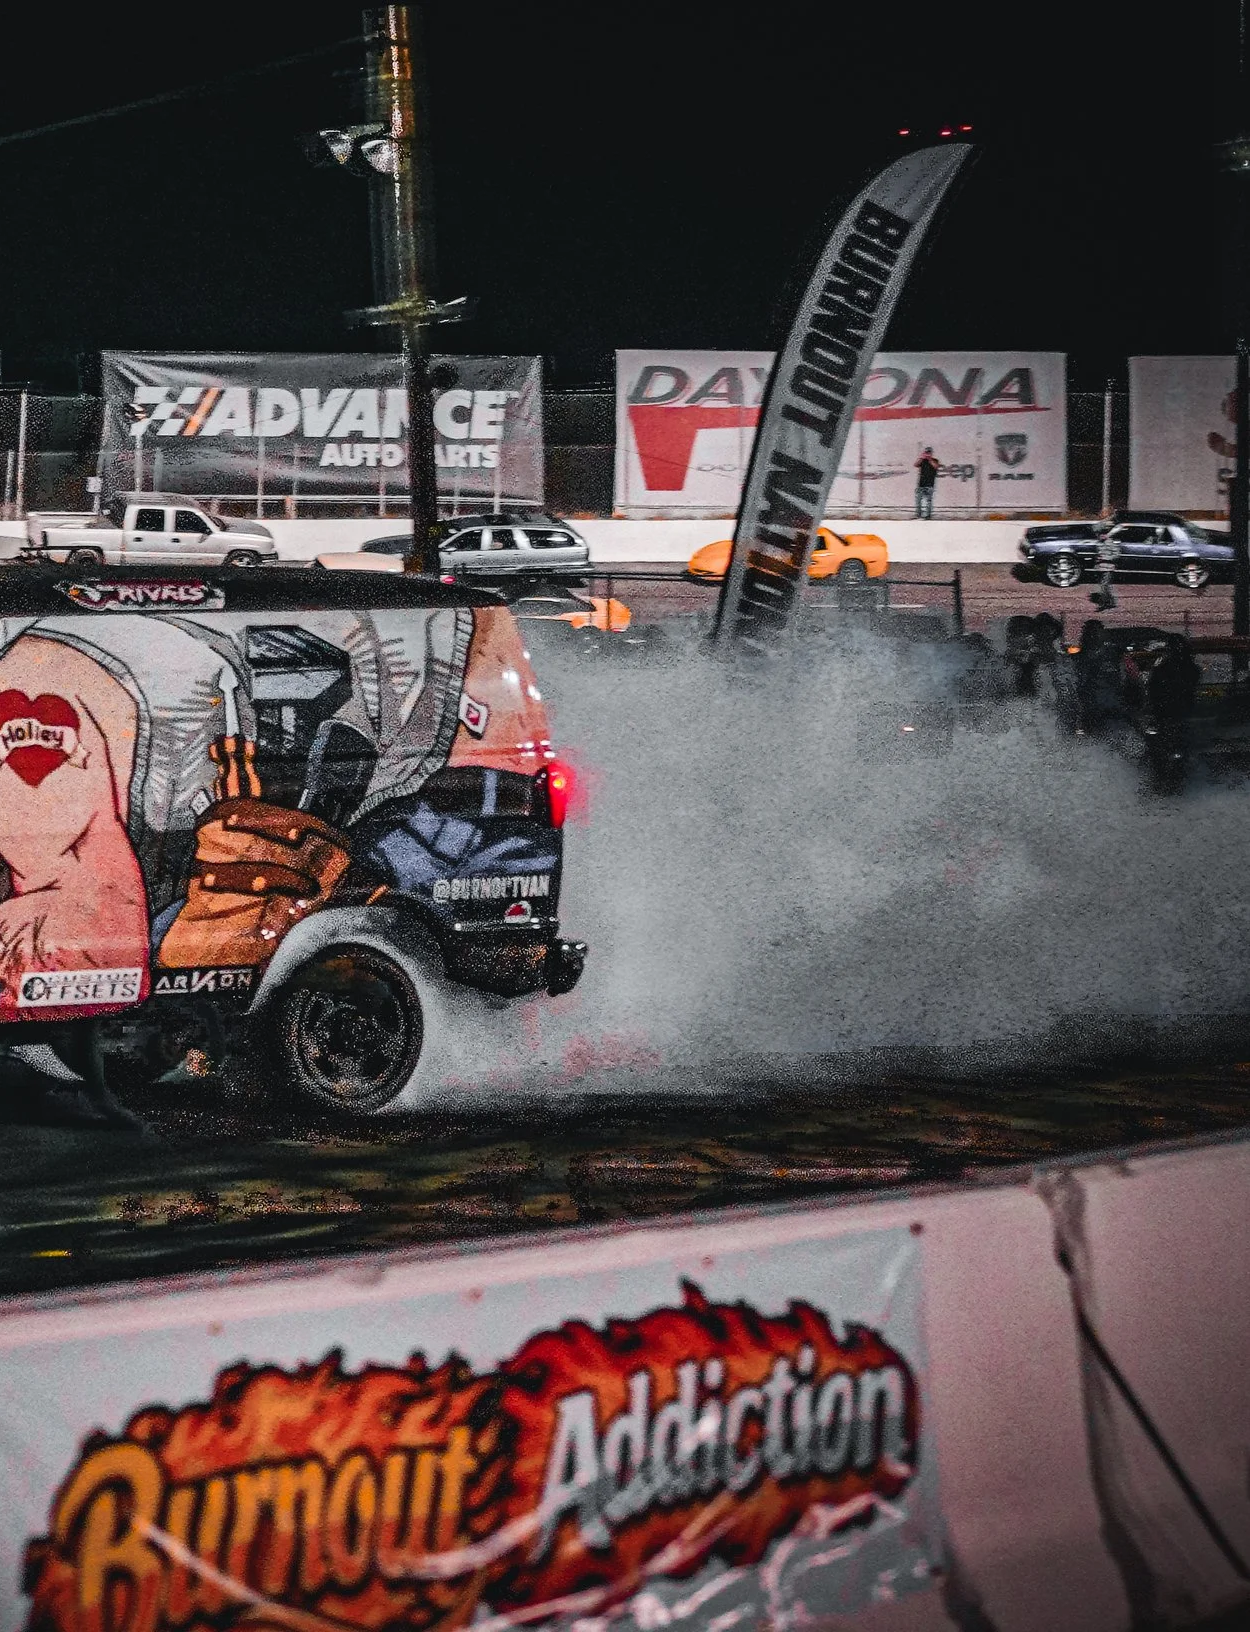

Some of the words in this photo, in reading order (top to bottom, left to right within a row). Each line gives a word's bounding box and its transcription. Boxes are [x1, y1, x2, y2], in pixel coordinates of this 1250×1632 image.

[781, 198, 913, 448] BURNOUT
[319, 443, 406, 468] AUTO
[935, 464, 976, 482] eep
[0, 720, 65, 750] Holley
[54, 1424, 478, 1632] Burnout
[527, 1342, 915, 1565] Addiction
